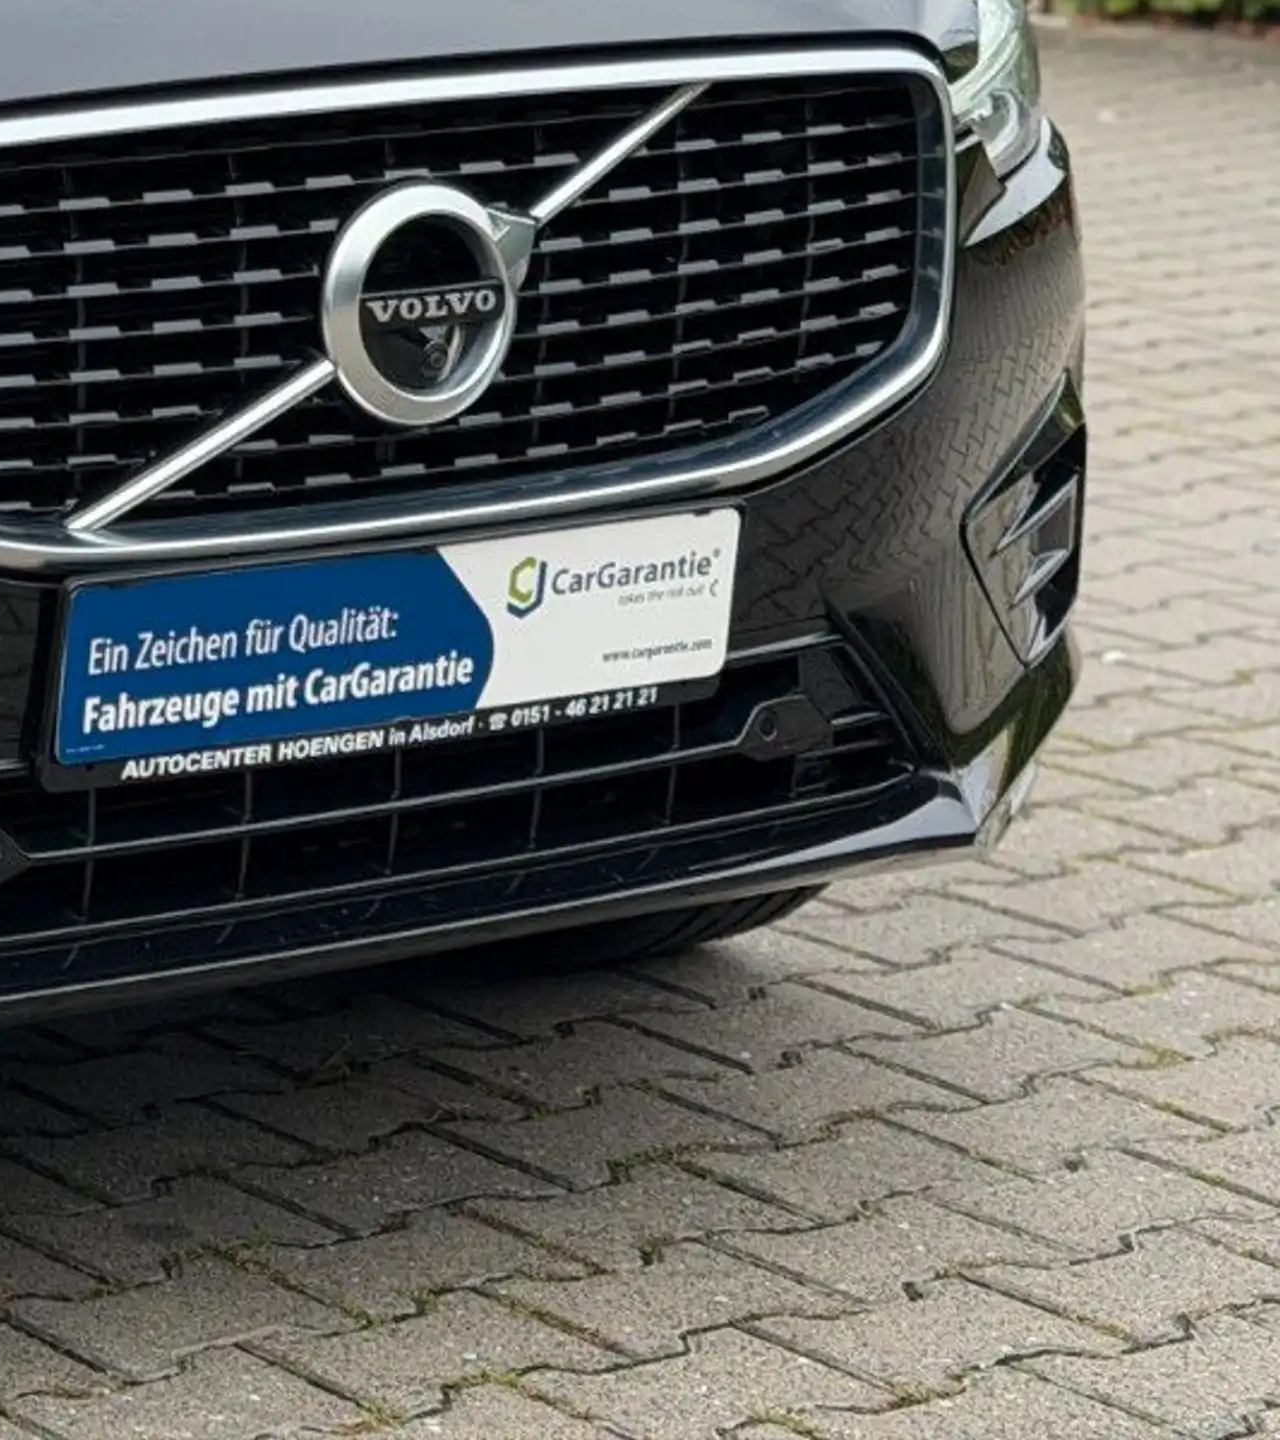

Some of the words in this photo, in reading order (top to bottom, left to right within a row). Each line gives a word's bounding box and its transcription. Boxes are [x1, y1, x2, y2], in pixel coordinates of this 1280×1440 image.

[365, 289, 497, 323] VOLVO
[88, 636, 129, 676] Ein
[135, 626, 238, 670] Zeichen
[245, 618, 285, 657] für
[288, 605, 399, 653] Qualität:
[82, 687, 240, 735] Fahrzeuge
[246, 673, 299, 714] mit
[304, 649, 474, 705] CarGarantie
[121, 743, 272, 781] AUTOCENTER
[278, 729, 384, 761] HOENGEN
[389, 728, 408, 746] in
[408, 715, 475, 743] Alsdorf
[511, 704, 550, 728] 0151
[564, 698, 587, 717] 46
[589, 693, 610, 713] 21
[613, 690, 633, 709] 21
[637, 686, 658, 705] 21
